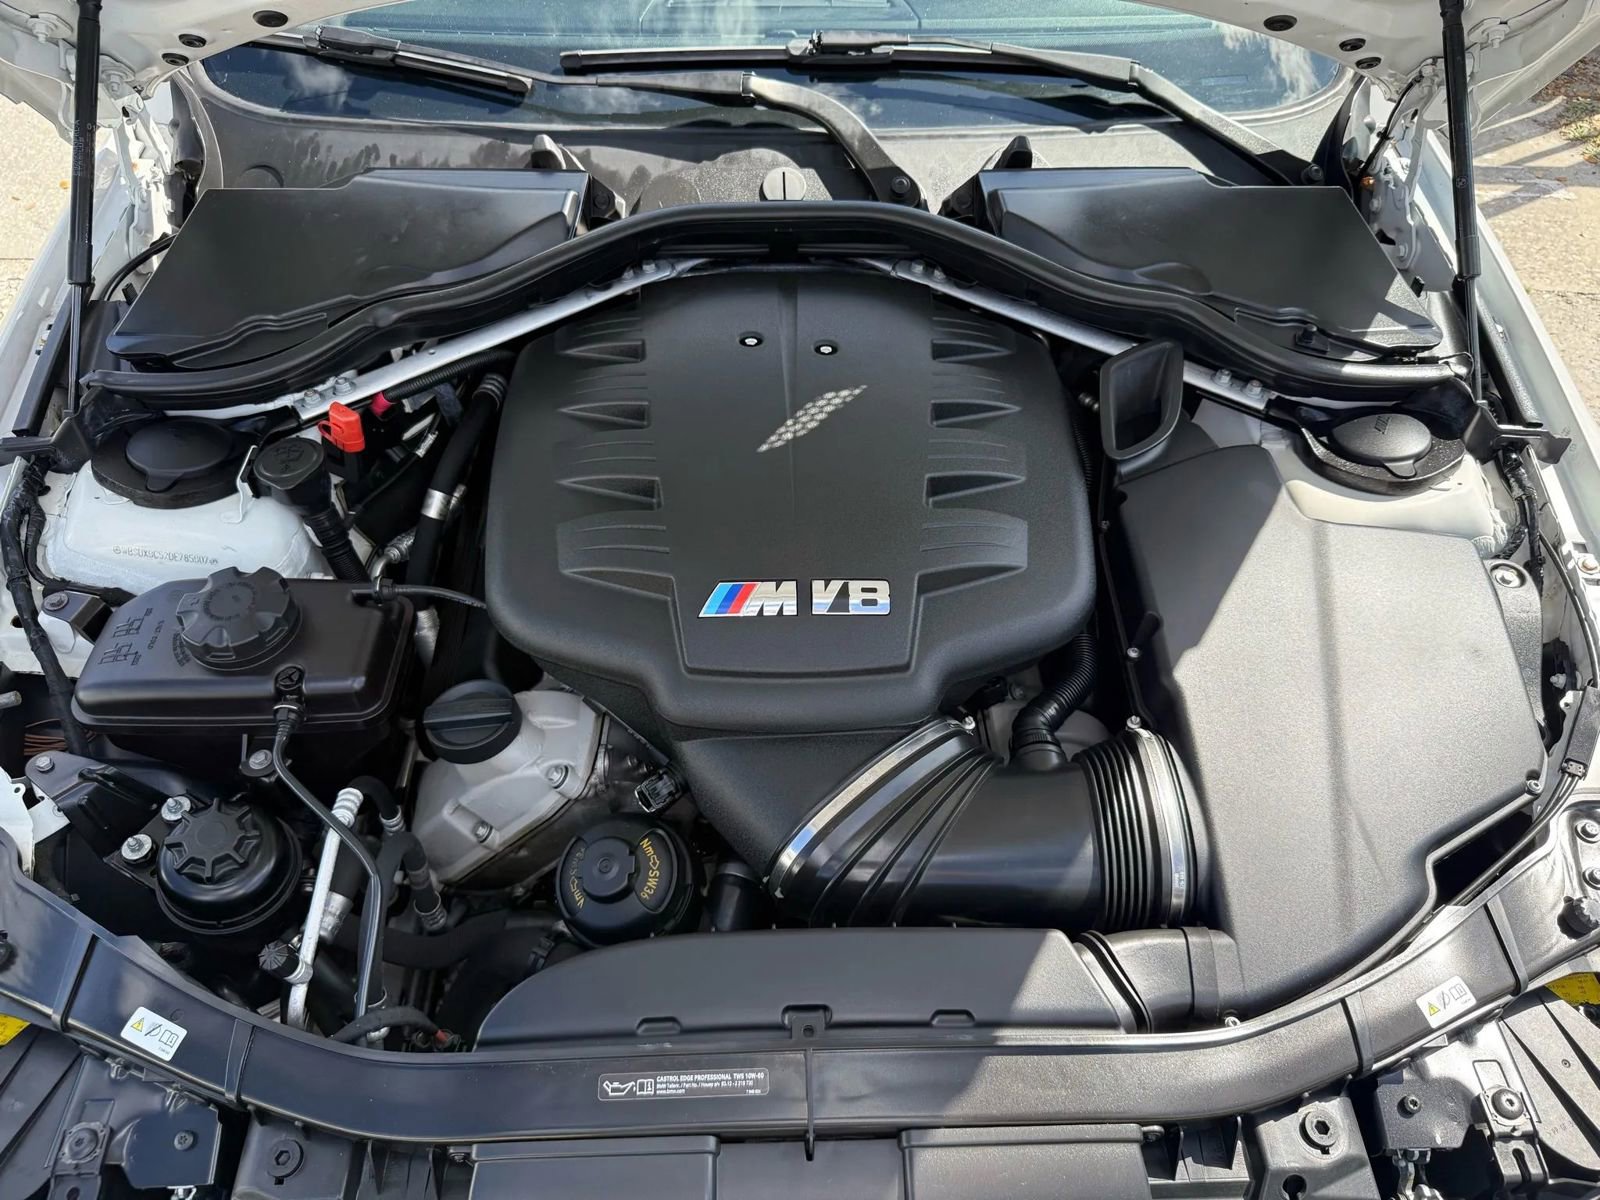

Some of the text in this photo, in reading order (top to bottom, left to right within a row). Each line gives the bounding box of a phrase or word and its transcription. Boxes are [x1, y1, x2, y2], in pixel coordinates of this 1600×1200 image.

[742, 579, 890, 617] M V8
[640, 838, 660, 899] Nm SW36
[694, 1073, 731, 1081] PROFESSIONAL
